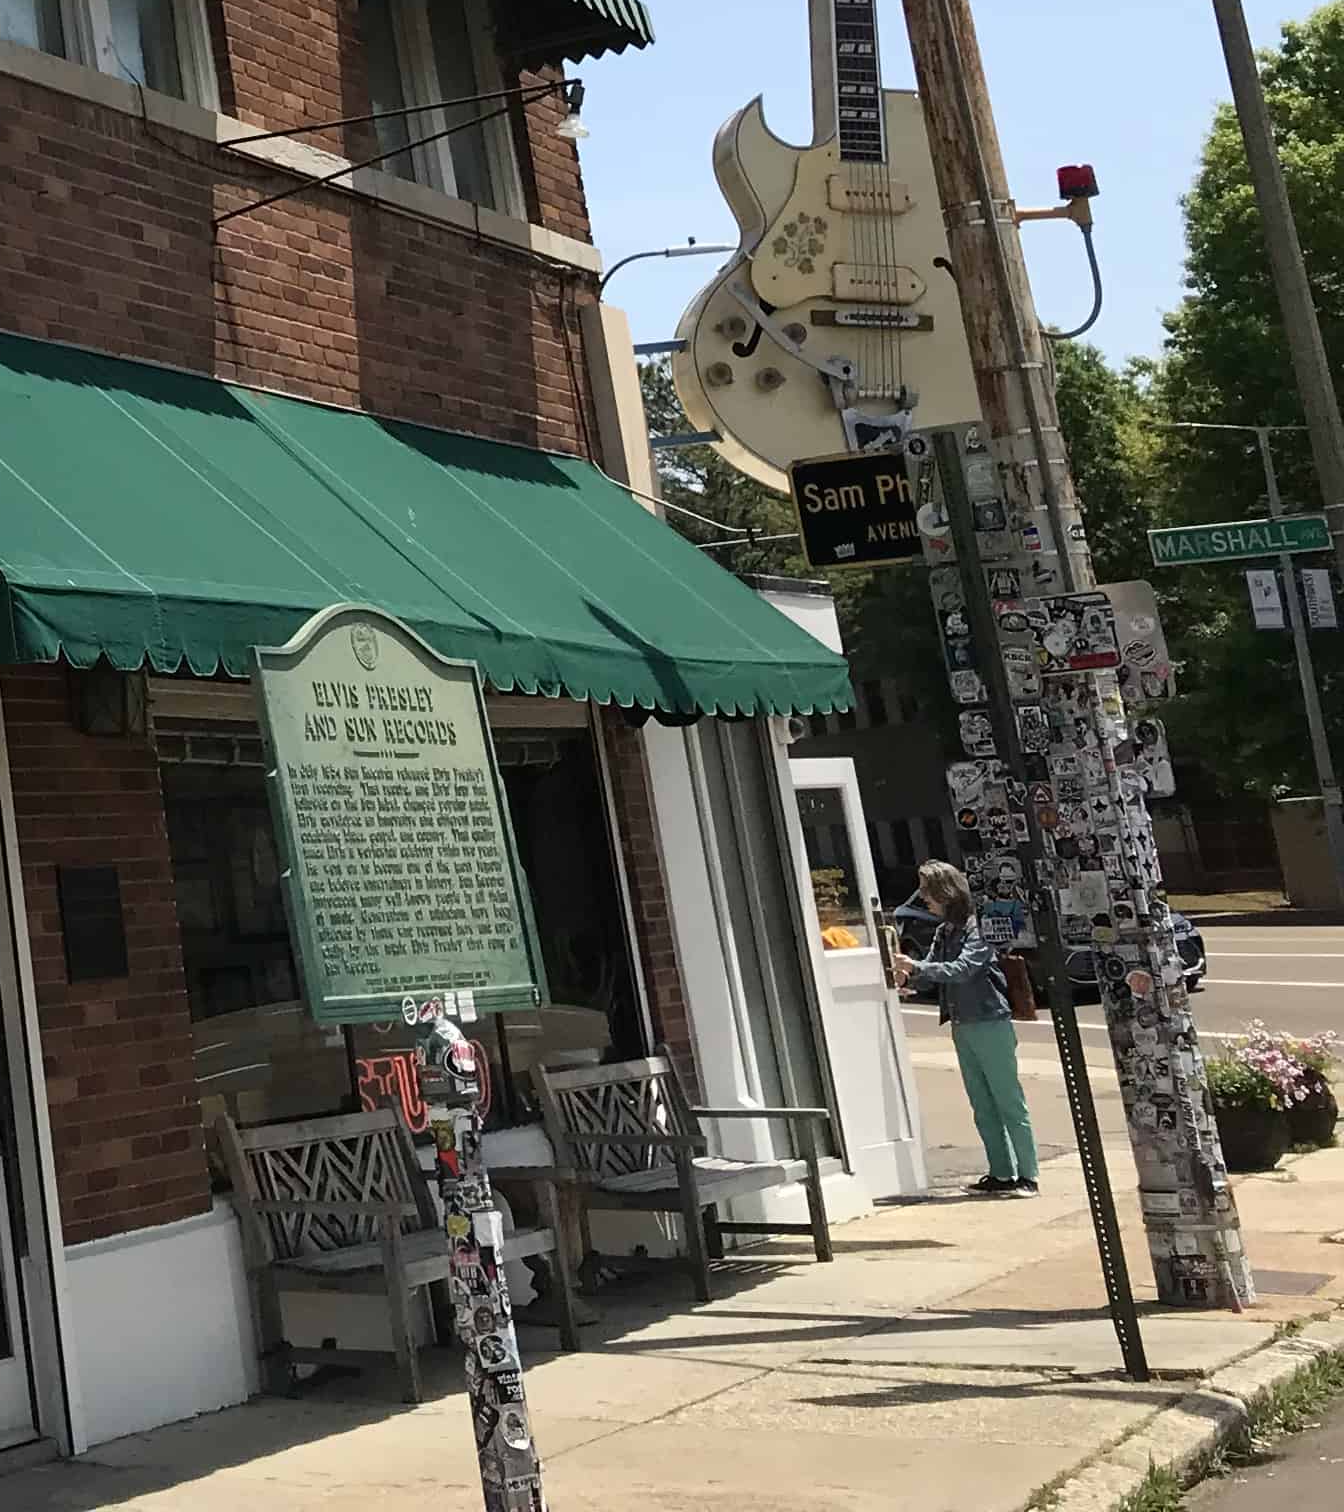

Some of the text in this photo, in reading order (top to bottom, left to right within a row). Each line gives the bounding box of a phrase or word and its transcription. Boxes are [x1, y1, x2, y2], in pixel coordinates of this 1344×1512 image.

[804, 483, 866, 513] Sam
[1155, 525, 1299, 558] MARSHALL
[312, 680, 434, 713] ELVIS PRESLEY
[304, 712, 457, 746] AND SUN RECORDS
